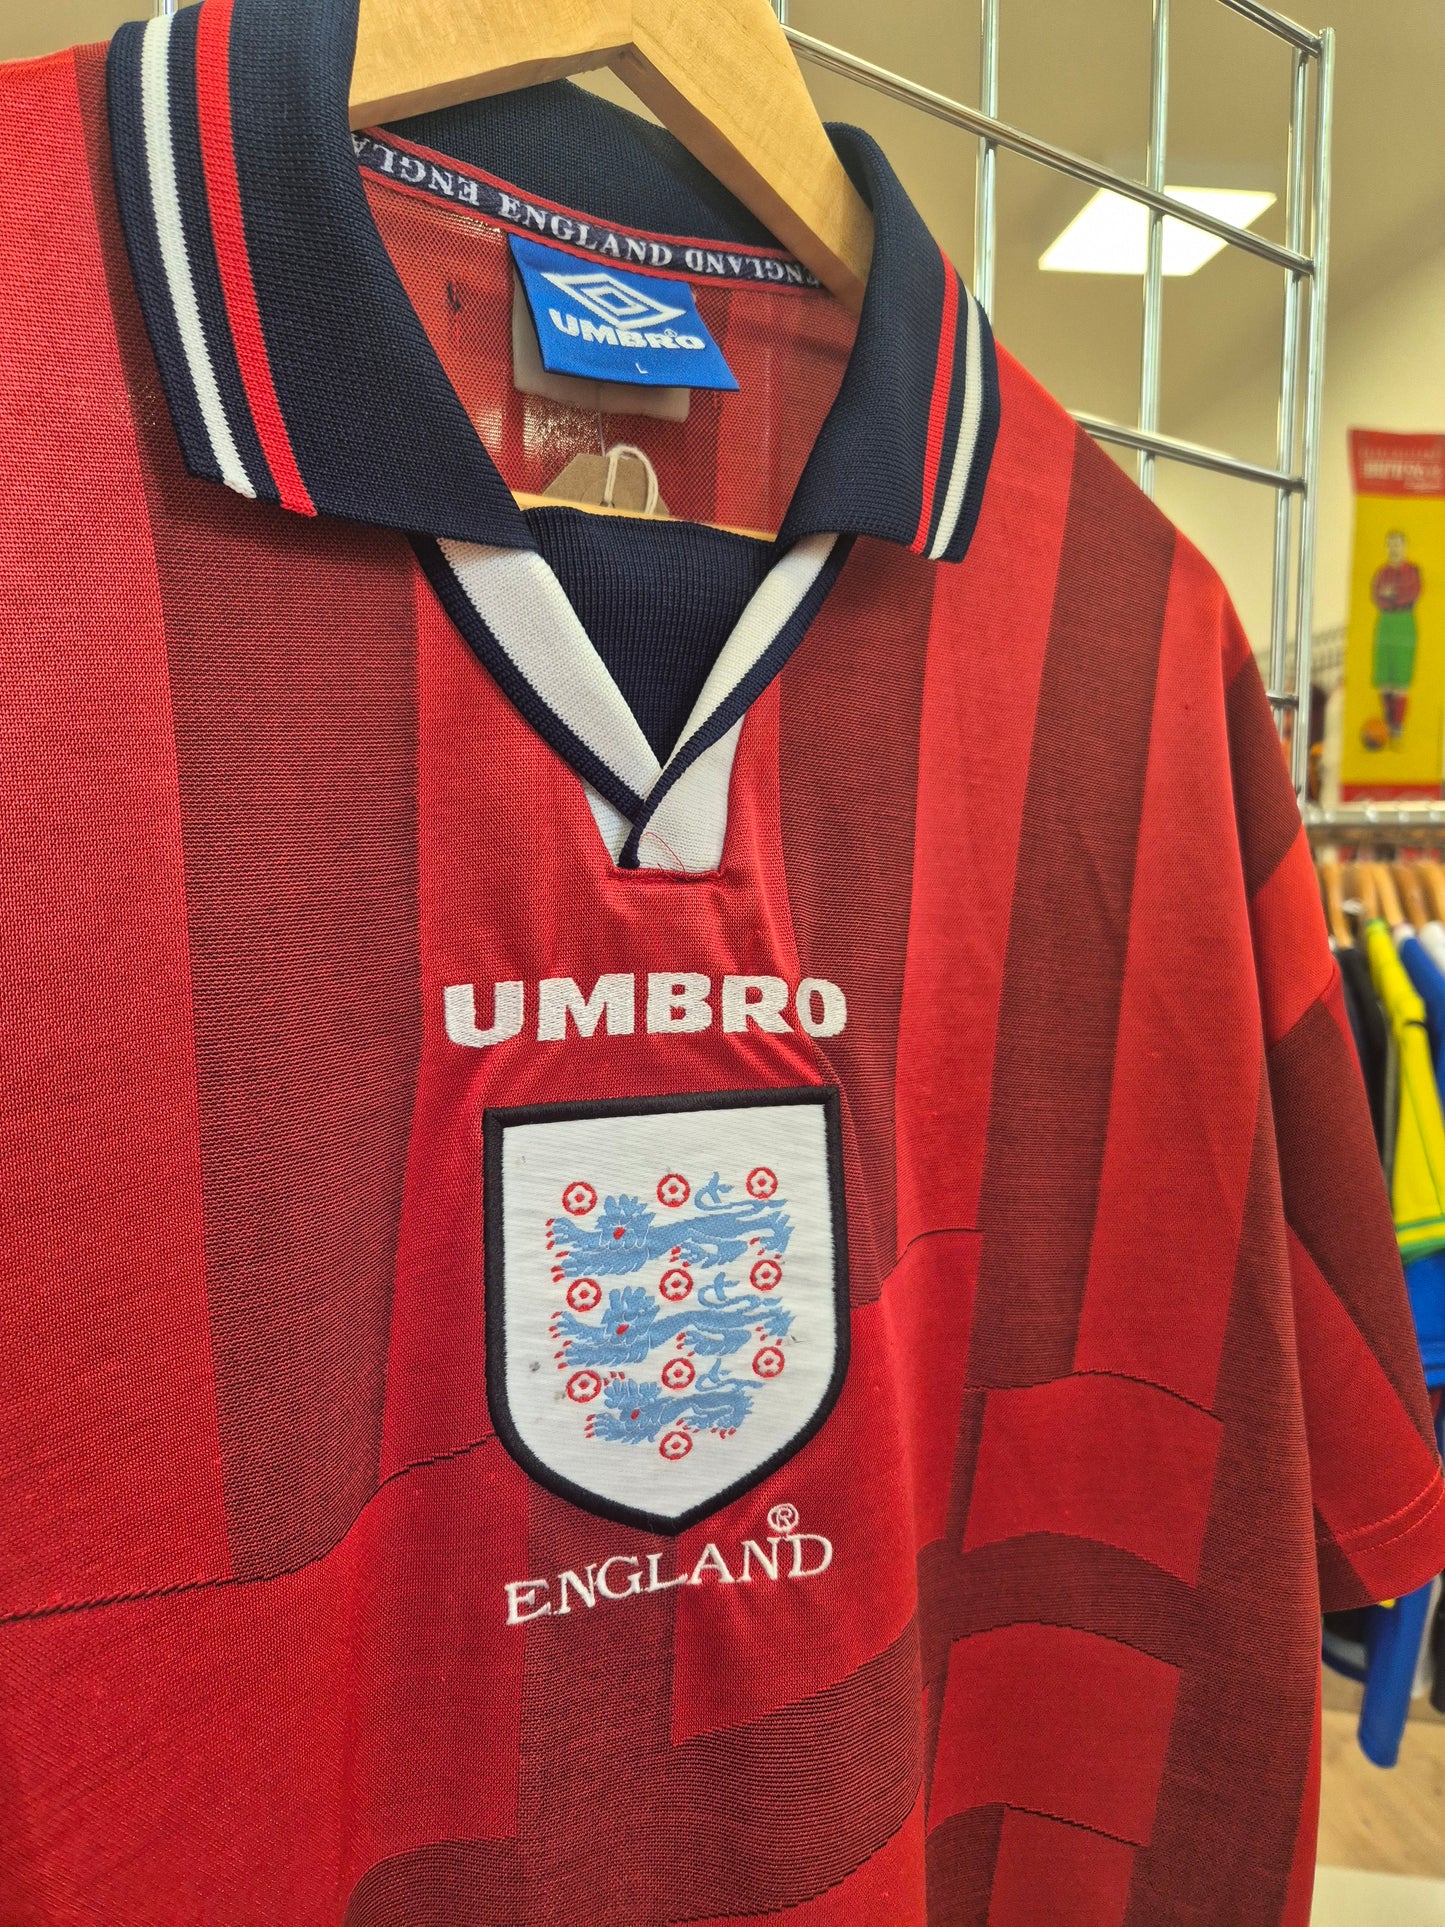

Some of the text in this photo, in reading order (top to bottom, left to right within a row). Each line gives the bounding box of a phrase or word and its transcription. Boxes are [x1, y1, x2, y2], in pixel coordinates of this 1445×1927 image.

[498, 190, 673, 268] ENGLAND
[549, 307, 705, 351] UMBRO
[635, 362, 648, 375] L
[443, 972, 848, 1049] UMBRO
[504, 1533, 834, 1626] ENGLAND
